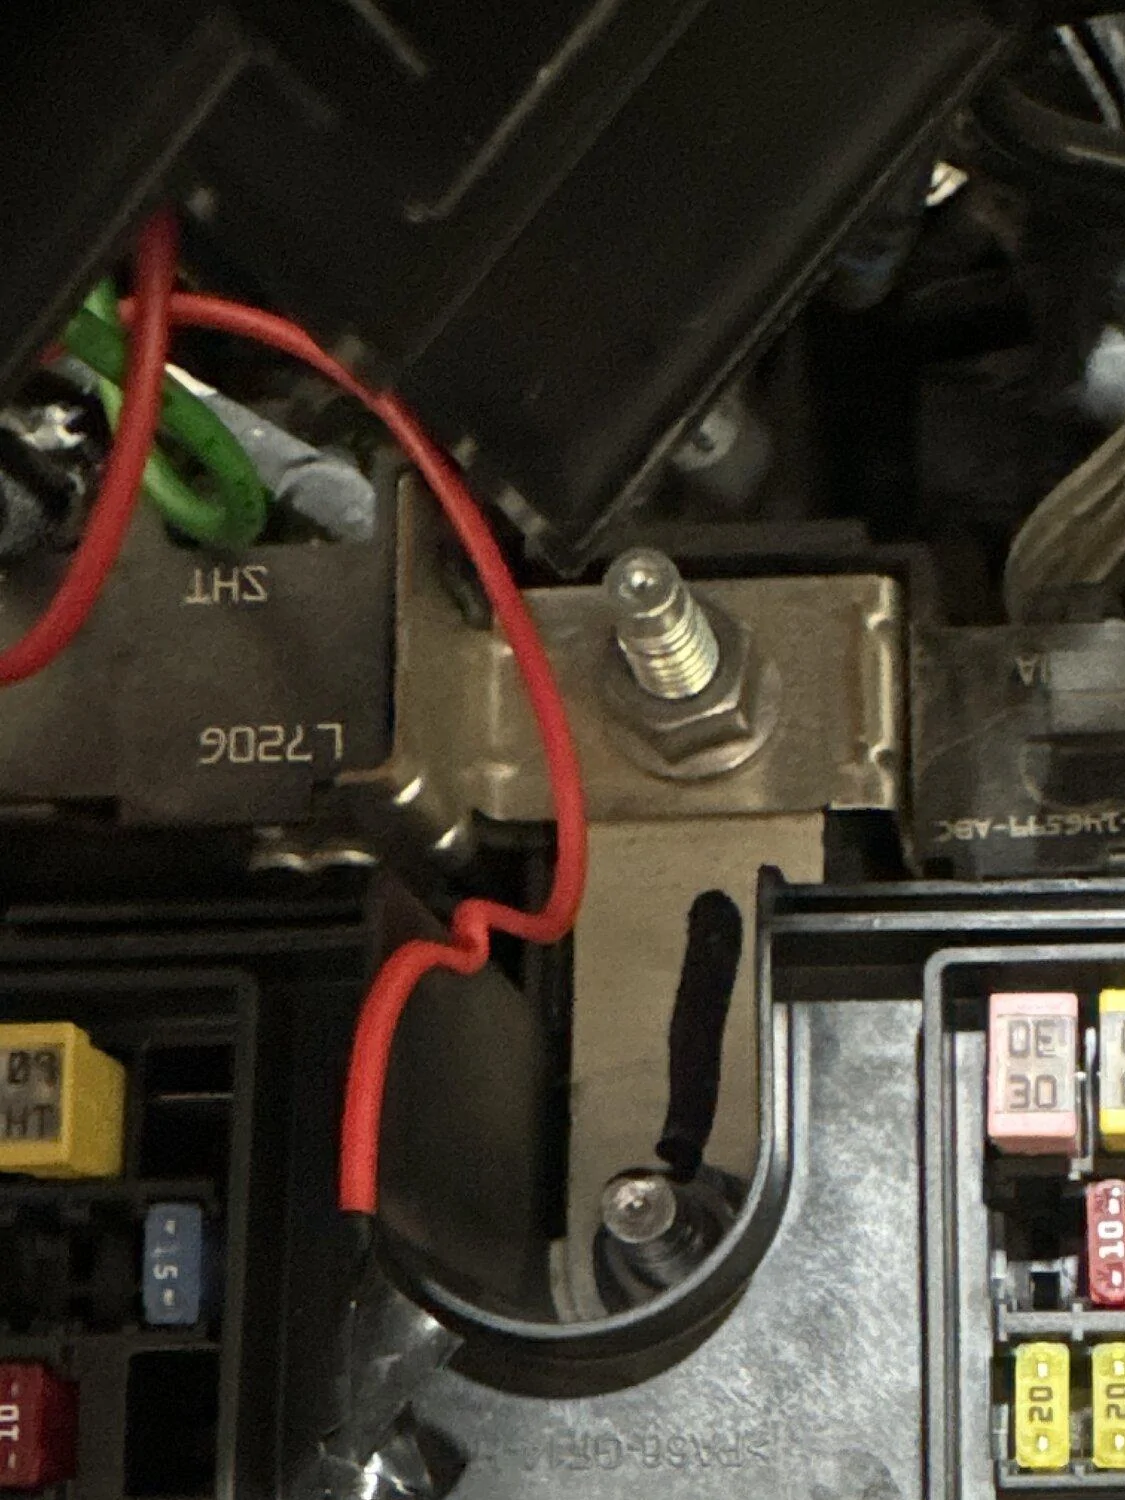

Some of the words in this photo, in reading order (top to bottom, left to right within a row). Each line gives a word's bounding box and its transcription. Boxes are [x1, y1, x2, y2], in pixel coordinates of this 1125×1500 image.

[1009, 1075, 1057, 1109] 30
[1097, 1221, 1125, 1259] 10
[1028, 1384, 1054, 1423] 20
